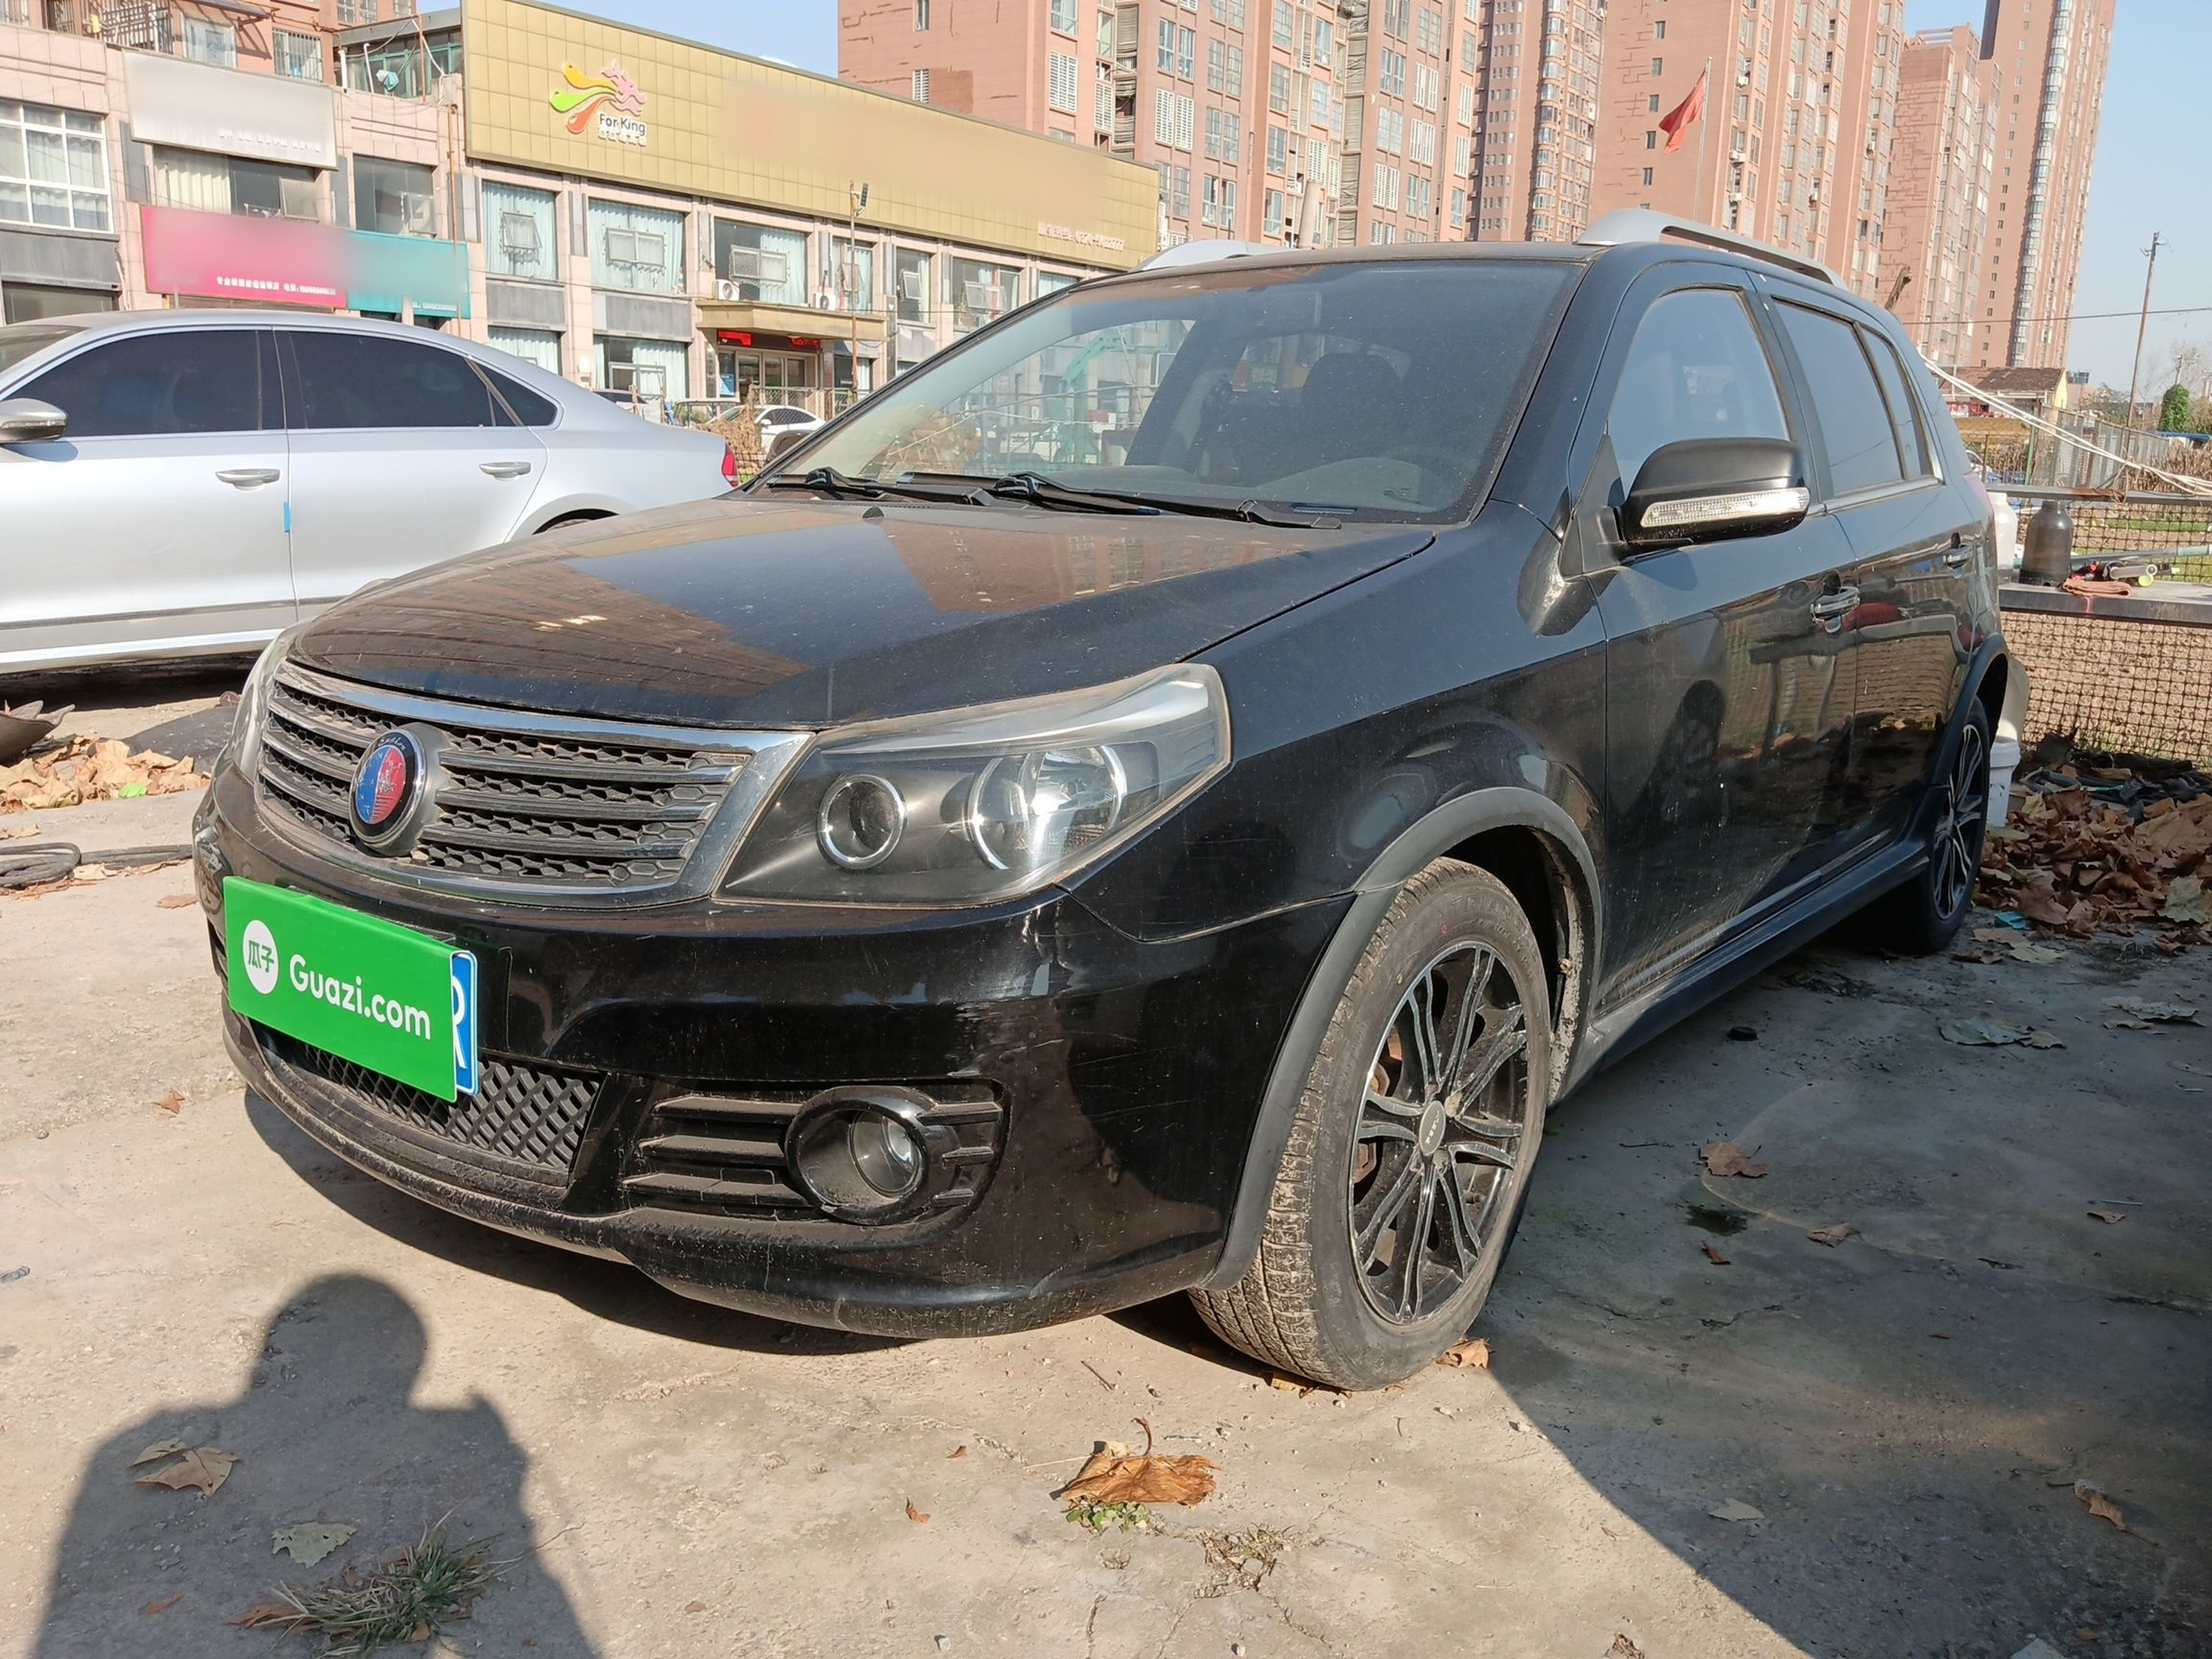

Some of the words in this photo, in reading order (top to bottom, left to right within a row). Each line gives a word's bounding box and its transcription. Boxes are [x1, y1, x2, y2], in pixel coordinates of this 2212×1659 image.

[600, 113, 618, 127] For
[620, 117, 645, 136] King
[248, 940, 274, 973] 瓜子
[290, 954, 431, 1040] Guazi.com
